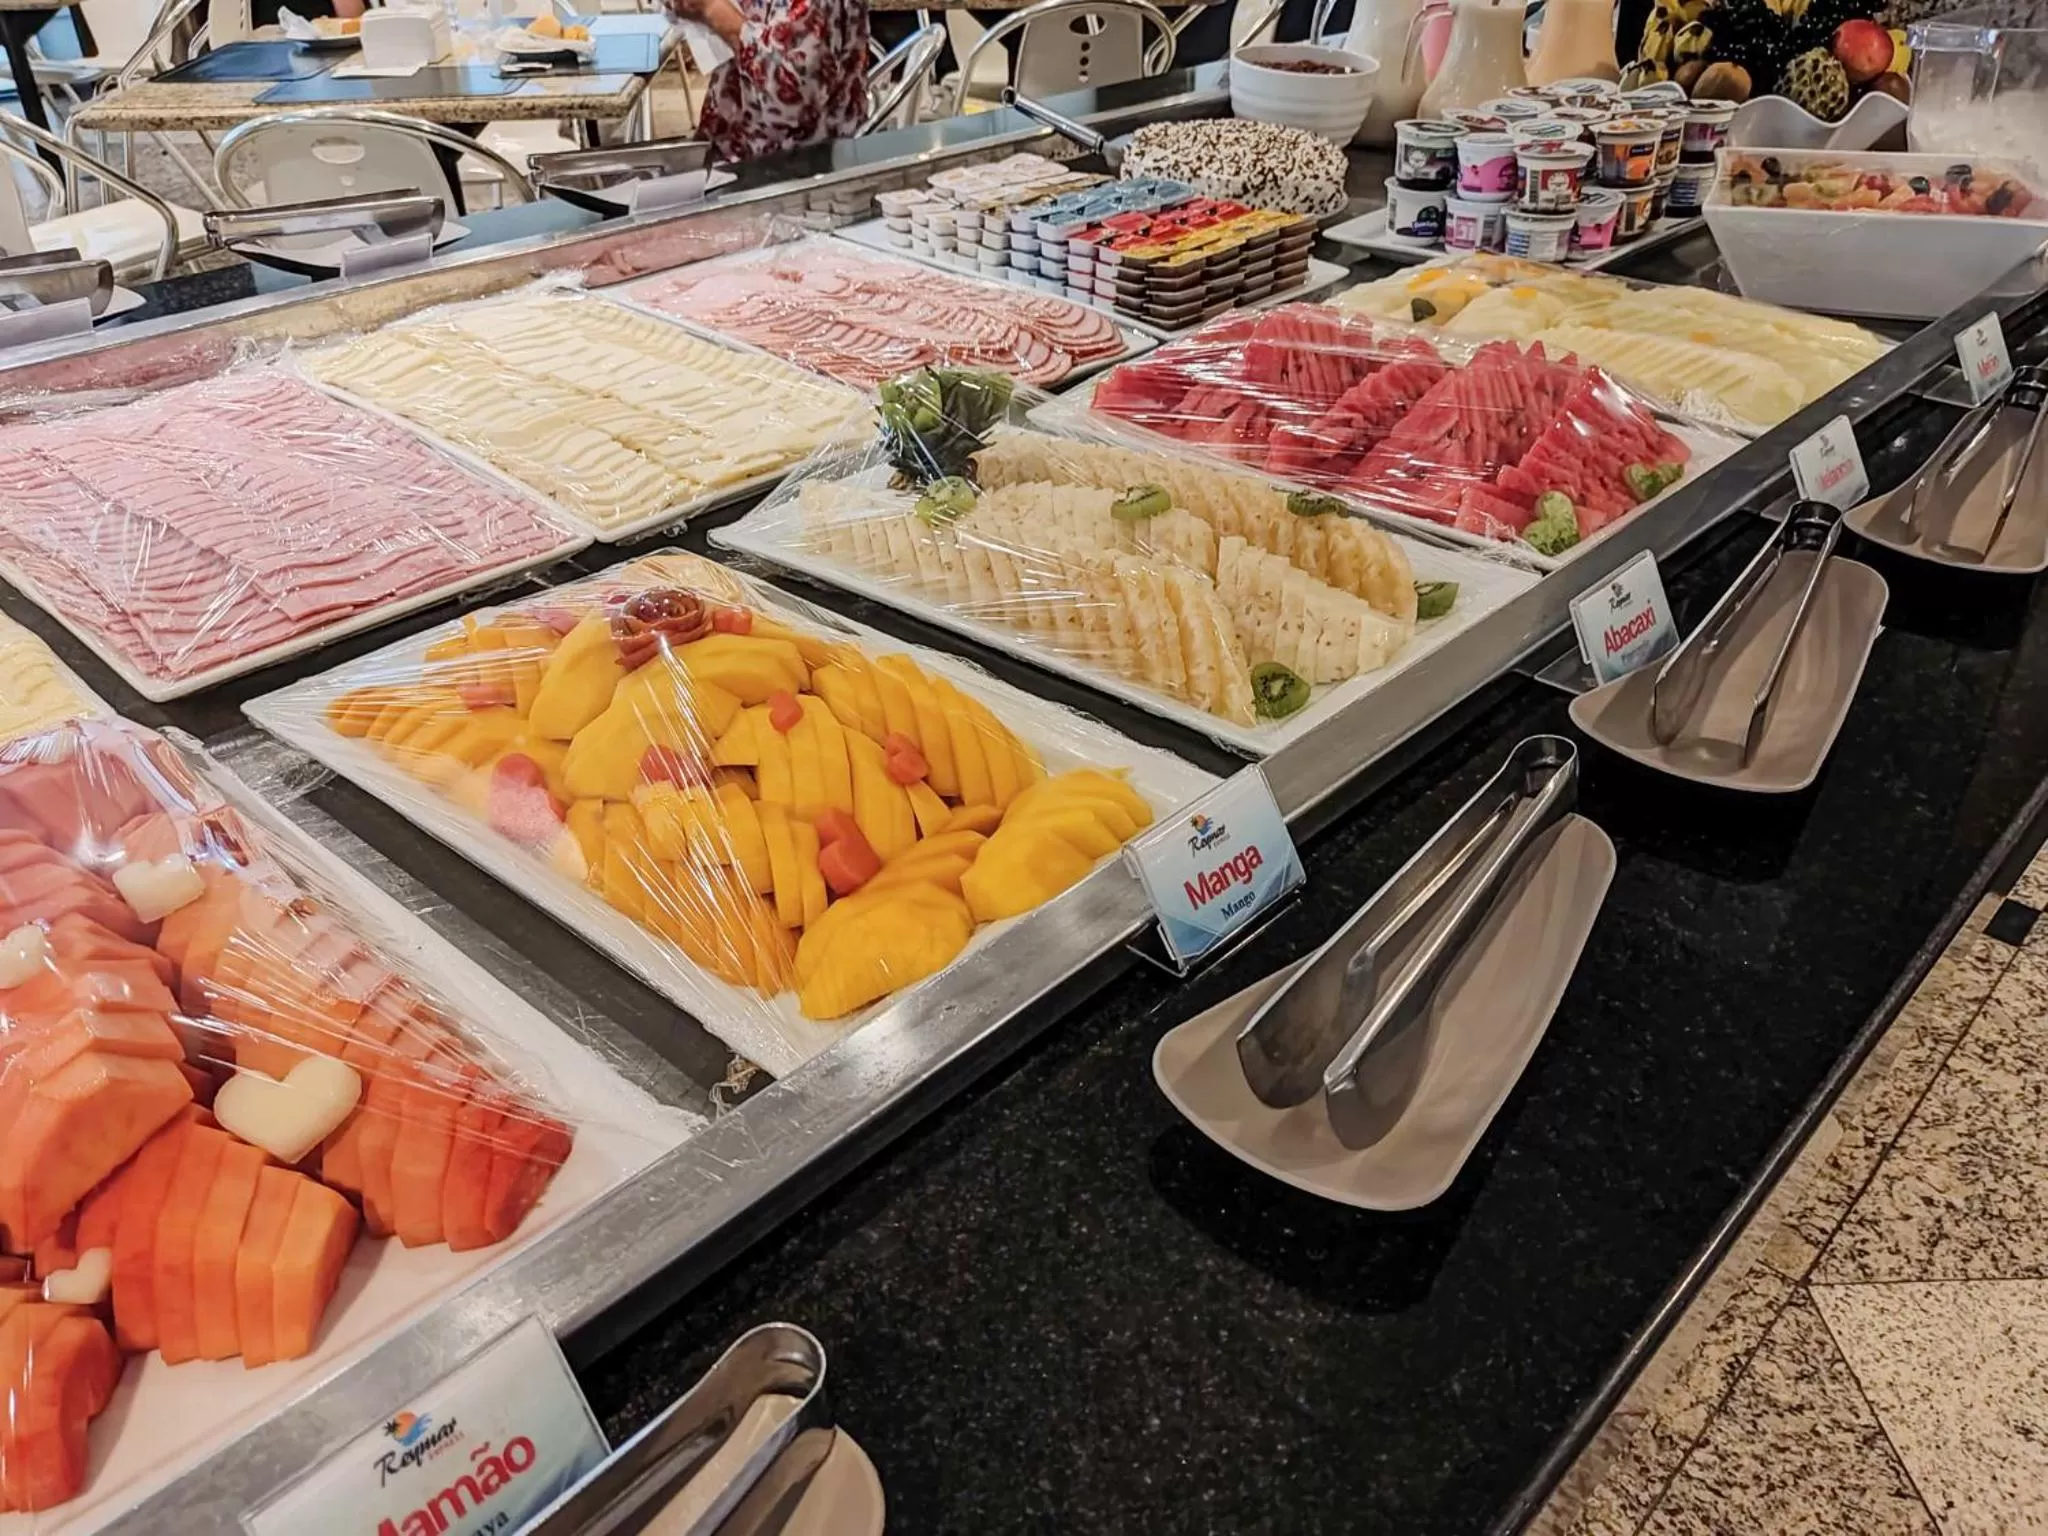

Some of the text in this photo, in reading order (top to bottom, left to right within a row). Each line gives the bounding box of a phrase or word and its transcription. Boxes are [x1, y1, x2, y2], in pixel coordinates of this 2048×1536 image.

[1604, 598, 1656, 658] Abacaxi
[1184, 845, 1263, 911] Manga
[1220, 891, 1256, 921] Mango
[373, 1417, 457, 1488] Reymar
